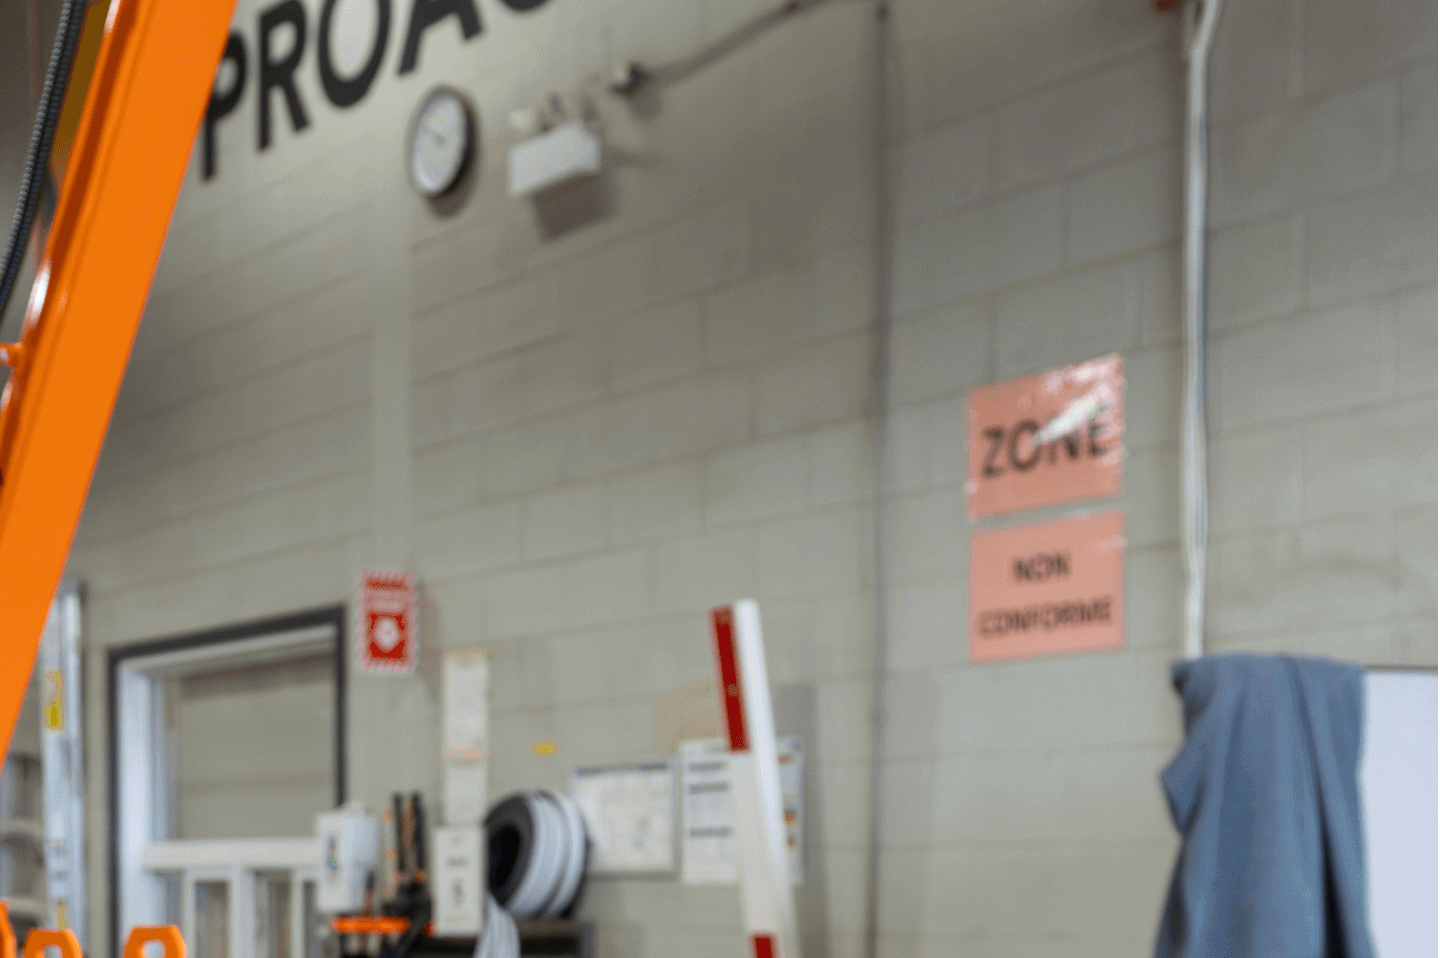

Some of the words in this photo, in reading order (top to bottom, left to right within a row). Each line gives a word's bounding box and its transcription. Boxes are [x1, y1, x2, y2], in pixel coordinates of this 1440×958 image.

[202, 0, 552, 181] PROA
[981, 403, 1110, 478] ZONE
[1012, 553, 1070, 582] NON
[978, 594, 1112, 638] CONFORME
